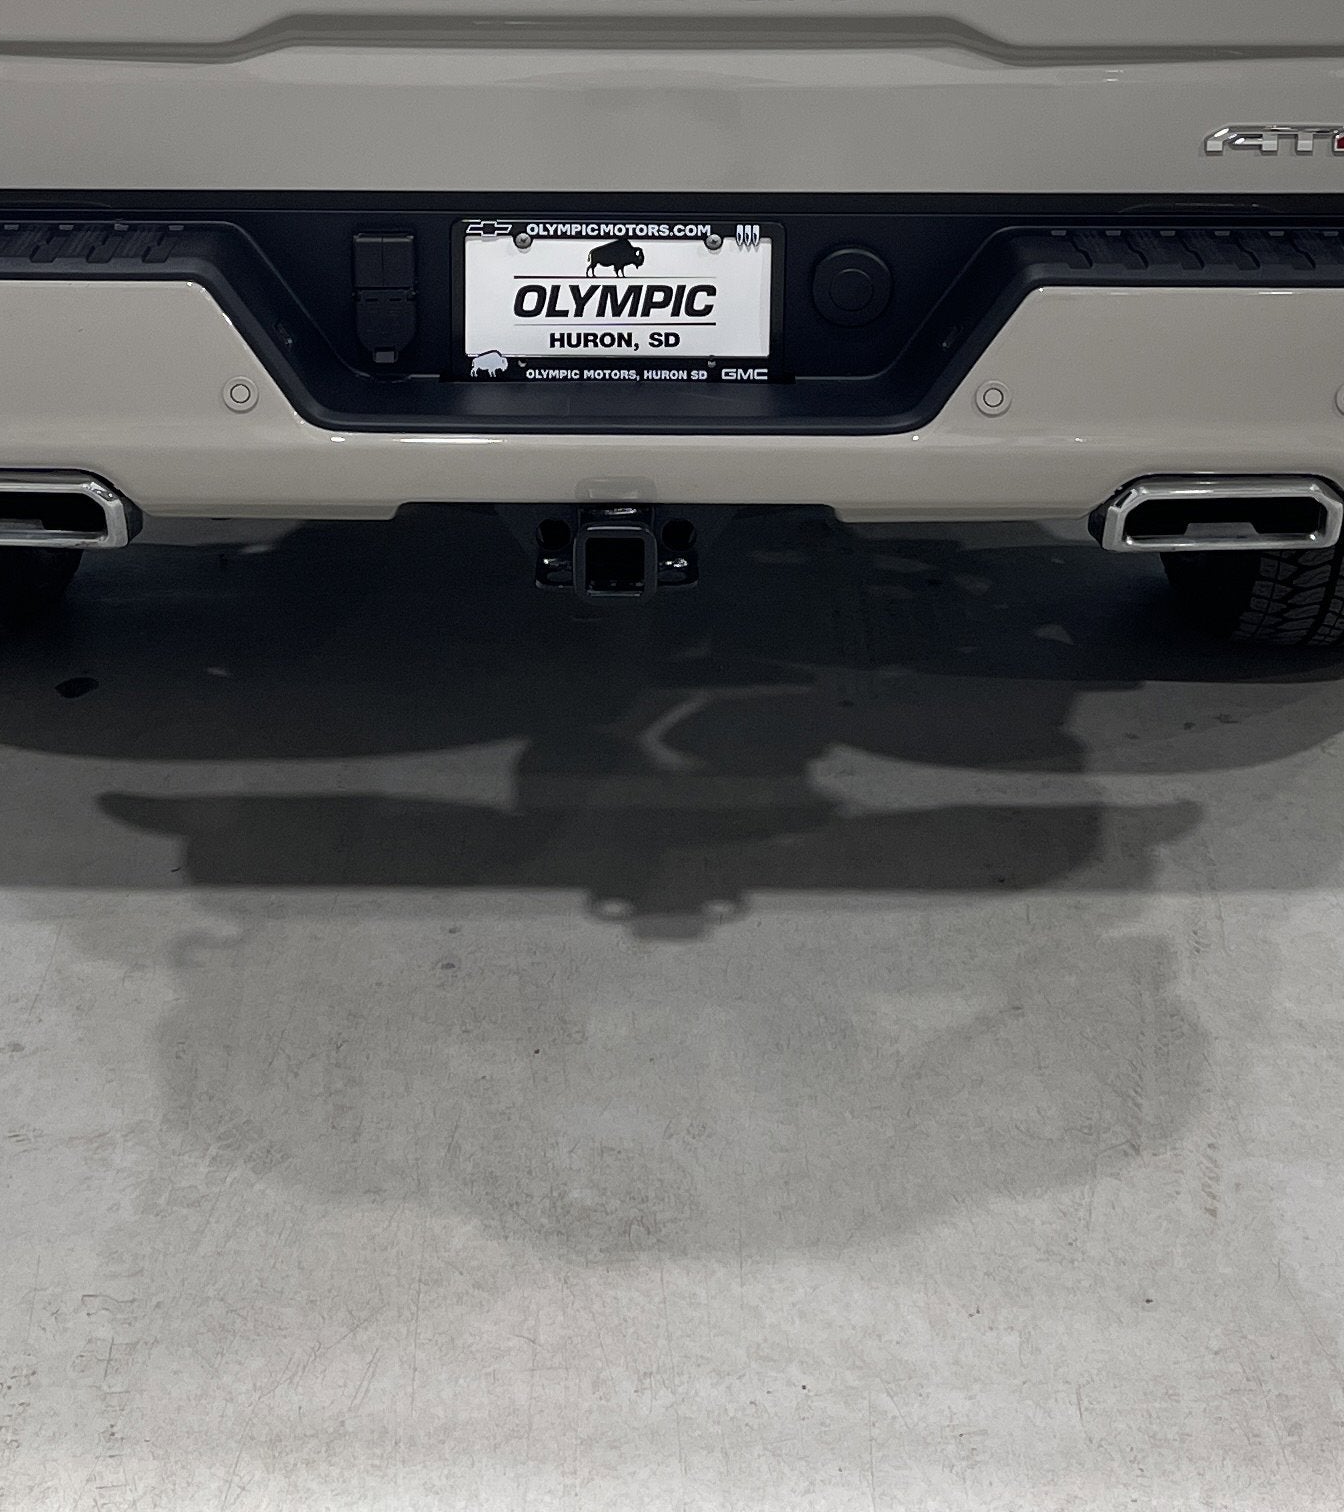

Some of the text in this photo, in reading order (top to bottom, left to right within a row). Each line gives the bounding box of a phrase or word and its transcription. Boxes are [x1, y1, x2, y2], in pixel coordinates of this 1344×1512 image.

[526, 223, 711, 237] OLYMPICMOTORS.COM
[513, 284, 717, 318] OLYMPIC
[549, 332, 681, 351] HURON, SD
[526, 368, 769, 381] OLYMPIC MOTORS, HURON SD GMC
